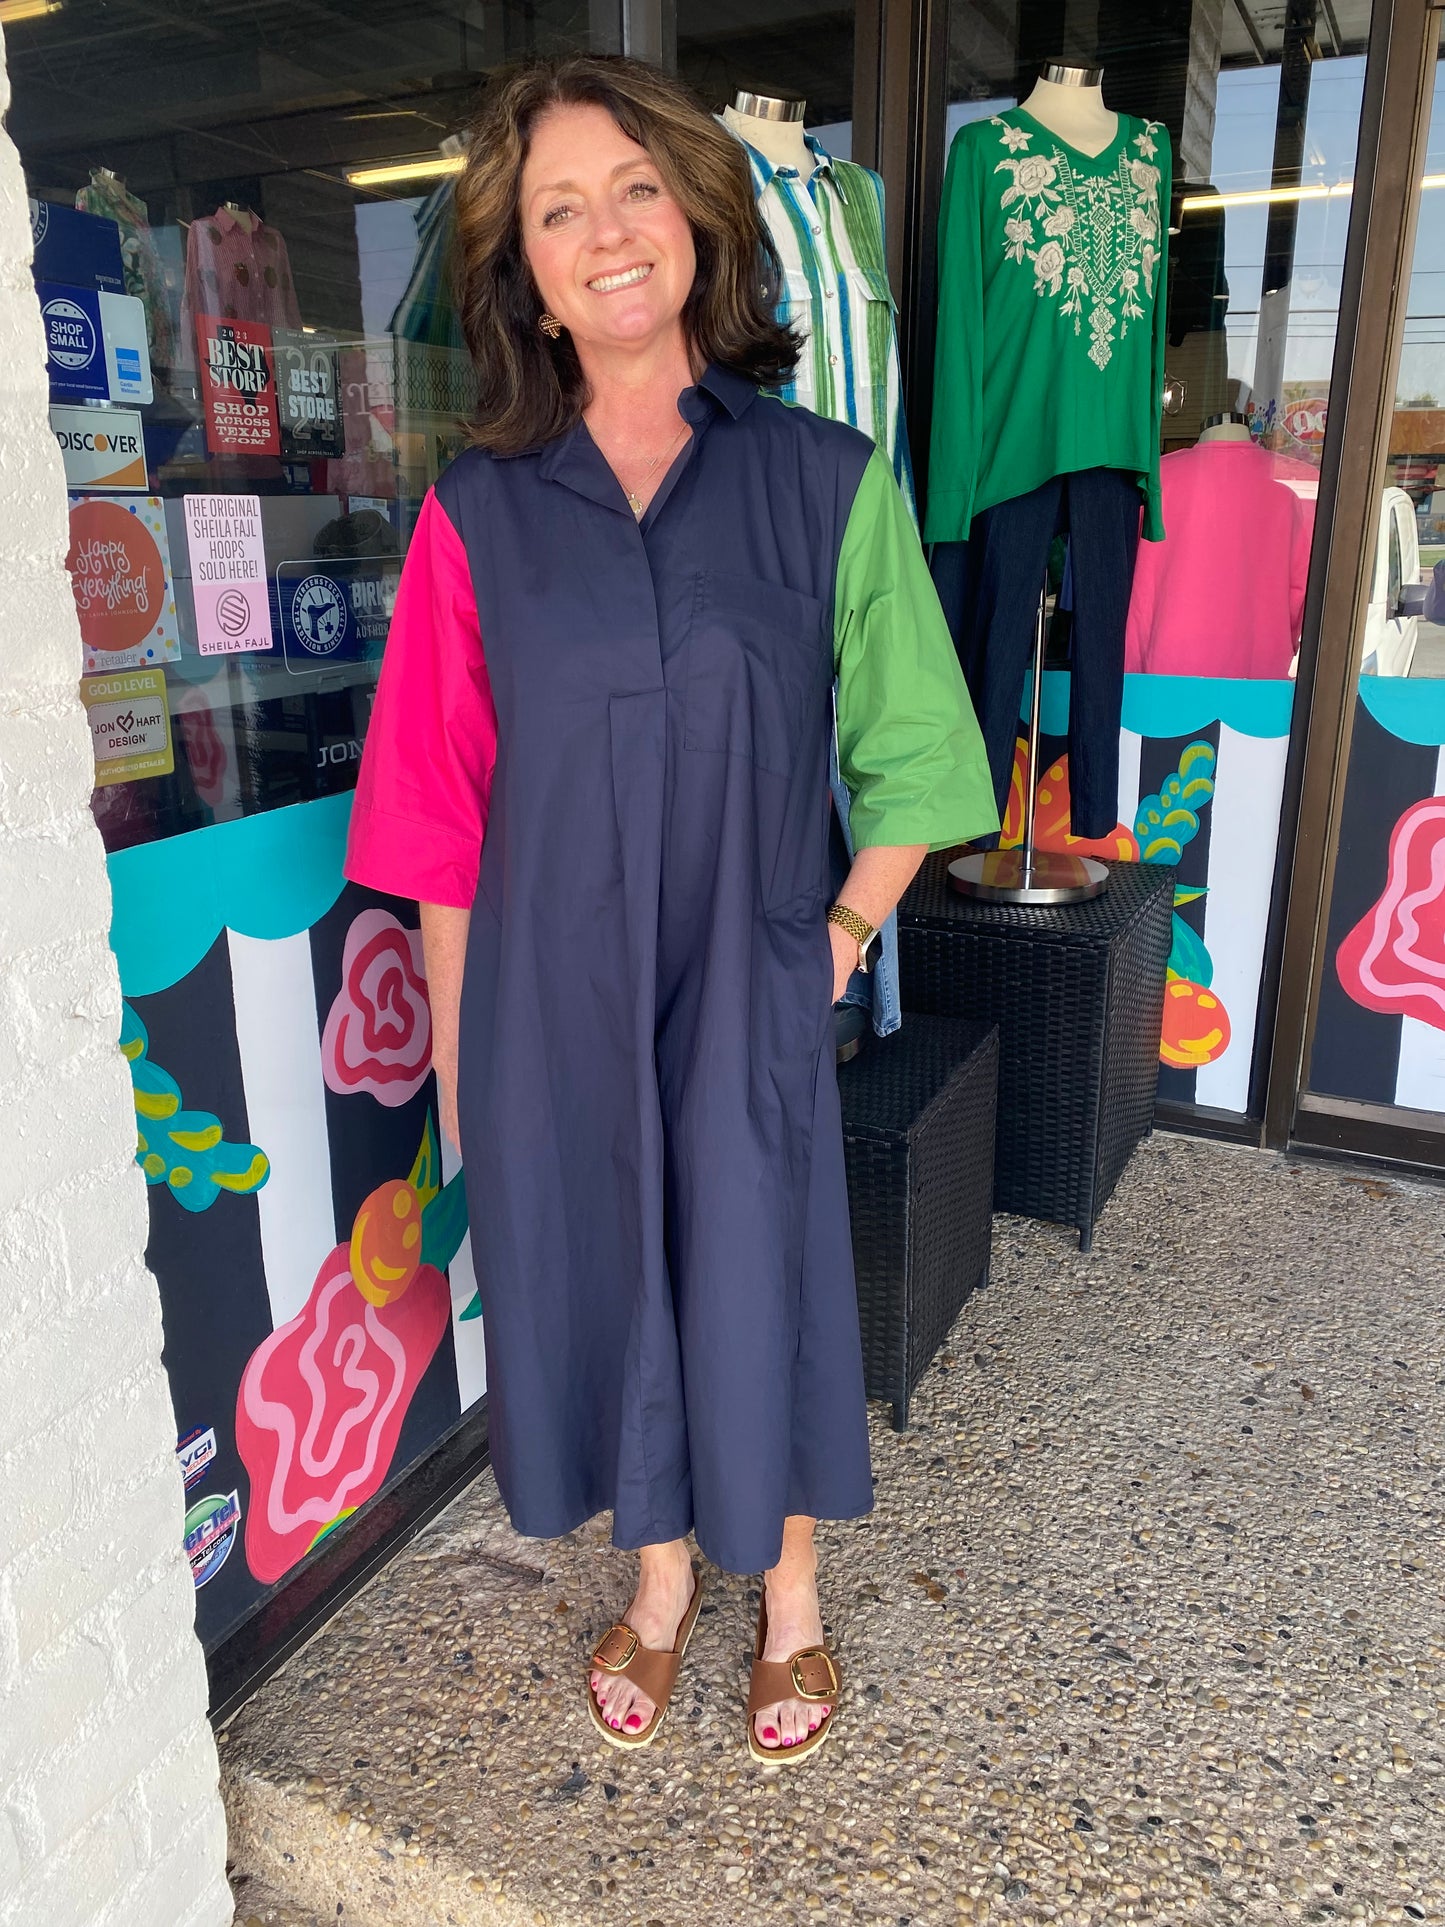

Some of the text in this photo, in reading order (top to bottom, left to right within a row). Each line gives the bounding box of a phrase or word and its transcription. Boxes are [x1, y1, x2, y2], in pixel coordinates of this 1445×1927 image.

[51, 320, 83, 336] SHOP
[222, 329, 248, 340] 2023
[49, 332, 88, 349] SMALL
[206, 338, 264, 371] BEST
[209, 366, 267, 392] STORE
[290, 368, 329, 394] BEST
[213, 402, 269, 417] SHOP
[288, 395, 335, 420] STORE
[214, 415, 270, 427] ACROSS
[215, 426, 272, 438] TEXAS
[222, 437, 265, 445] .COM
[56, 431, 138, 454] DISCOVER
[186, 498, 258, 517] THE ORIGINAL
[193, 519, 257, 538] SHEILA FAJL
[76, 538, 131, 575] Happy
[209, 540, 245, 559] HOOPS
[199, 560, 258, 581] SOLD HERE!
[296, 578, 341, 602] BIRKENSTOCK
[294, 610, 322, 652] TRADITION
[356, 622, 389, 639] AUTHOR
[201, 637, 270, 652] SHEILA FAJL
[323, 630, 342, 651] SINCE
[100, 652, 137, 667] retailer
[88, 677, 156, 697] GOLD LEVEL
[94, 715, 161, 735] JON HART
[109, 733, 146, 748] DESIGN
[180, 1438, 212, 1468] VGI
[183, 1494, 237, 1551] er-Tel
